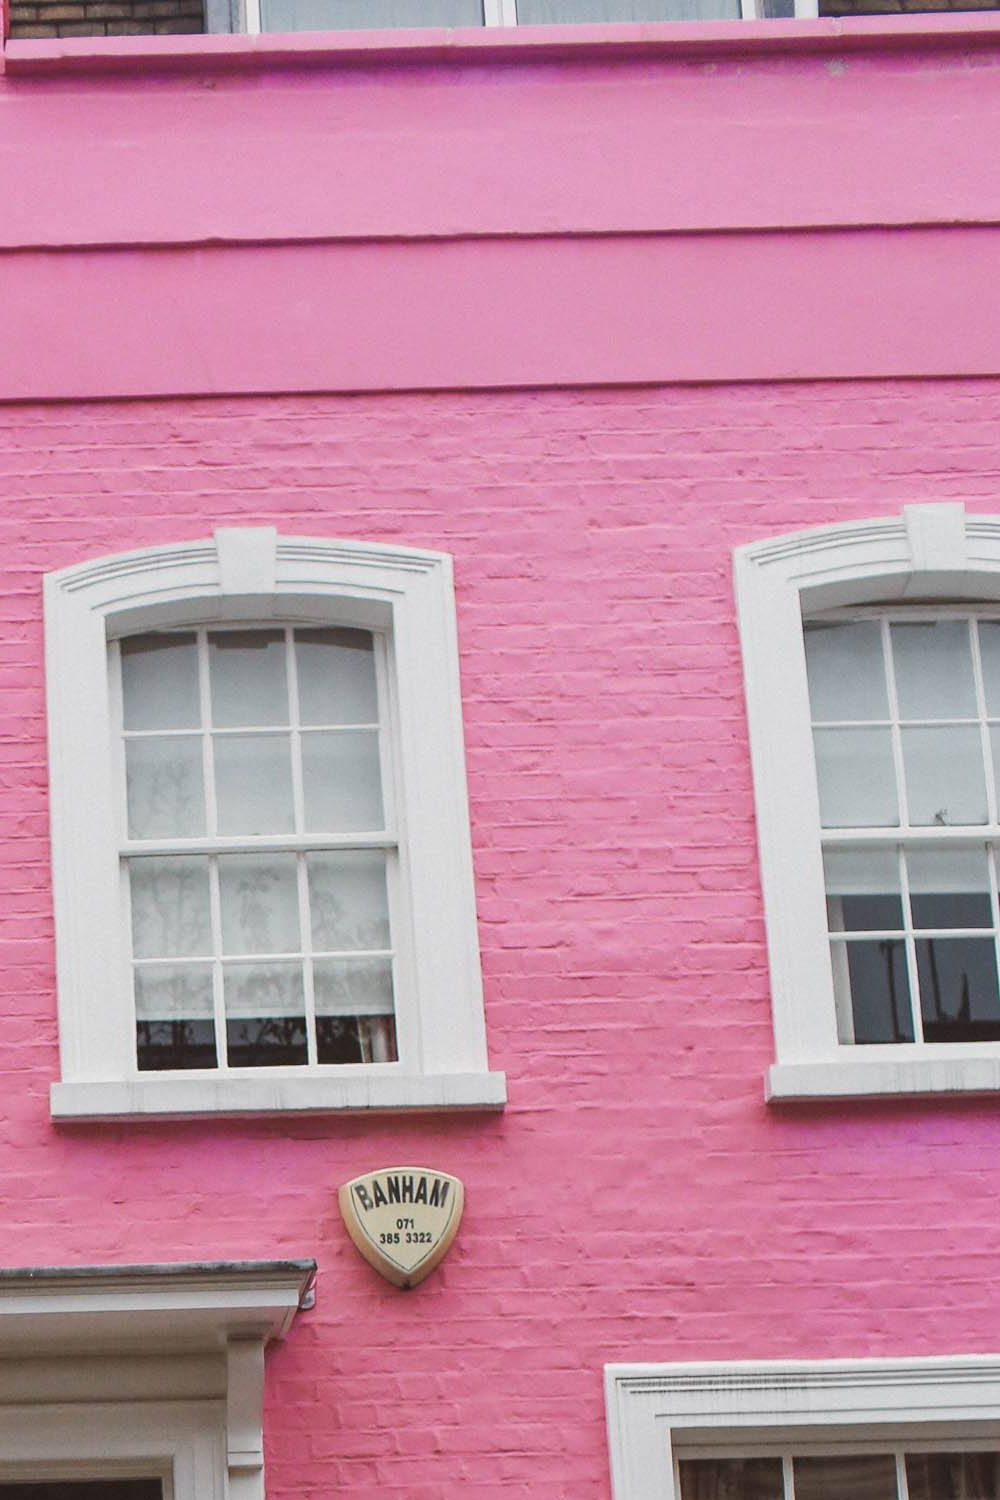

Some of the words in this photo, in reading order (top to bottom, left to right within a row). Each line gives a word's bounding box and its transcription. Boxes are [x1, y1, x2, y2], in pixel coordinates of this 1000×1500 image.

[355, 1175, 450, 1212] BANHAM
[396, 1218, 414, 1229] 071
[380, 1234, 400, 1244] 385
[405, 1232, 432, 1243] 3322
